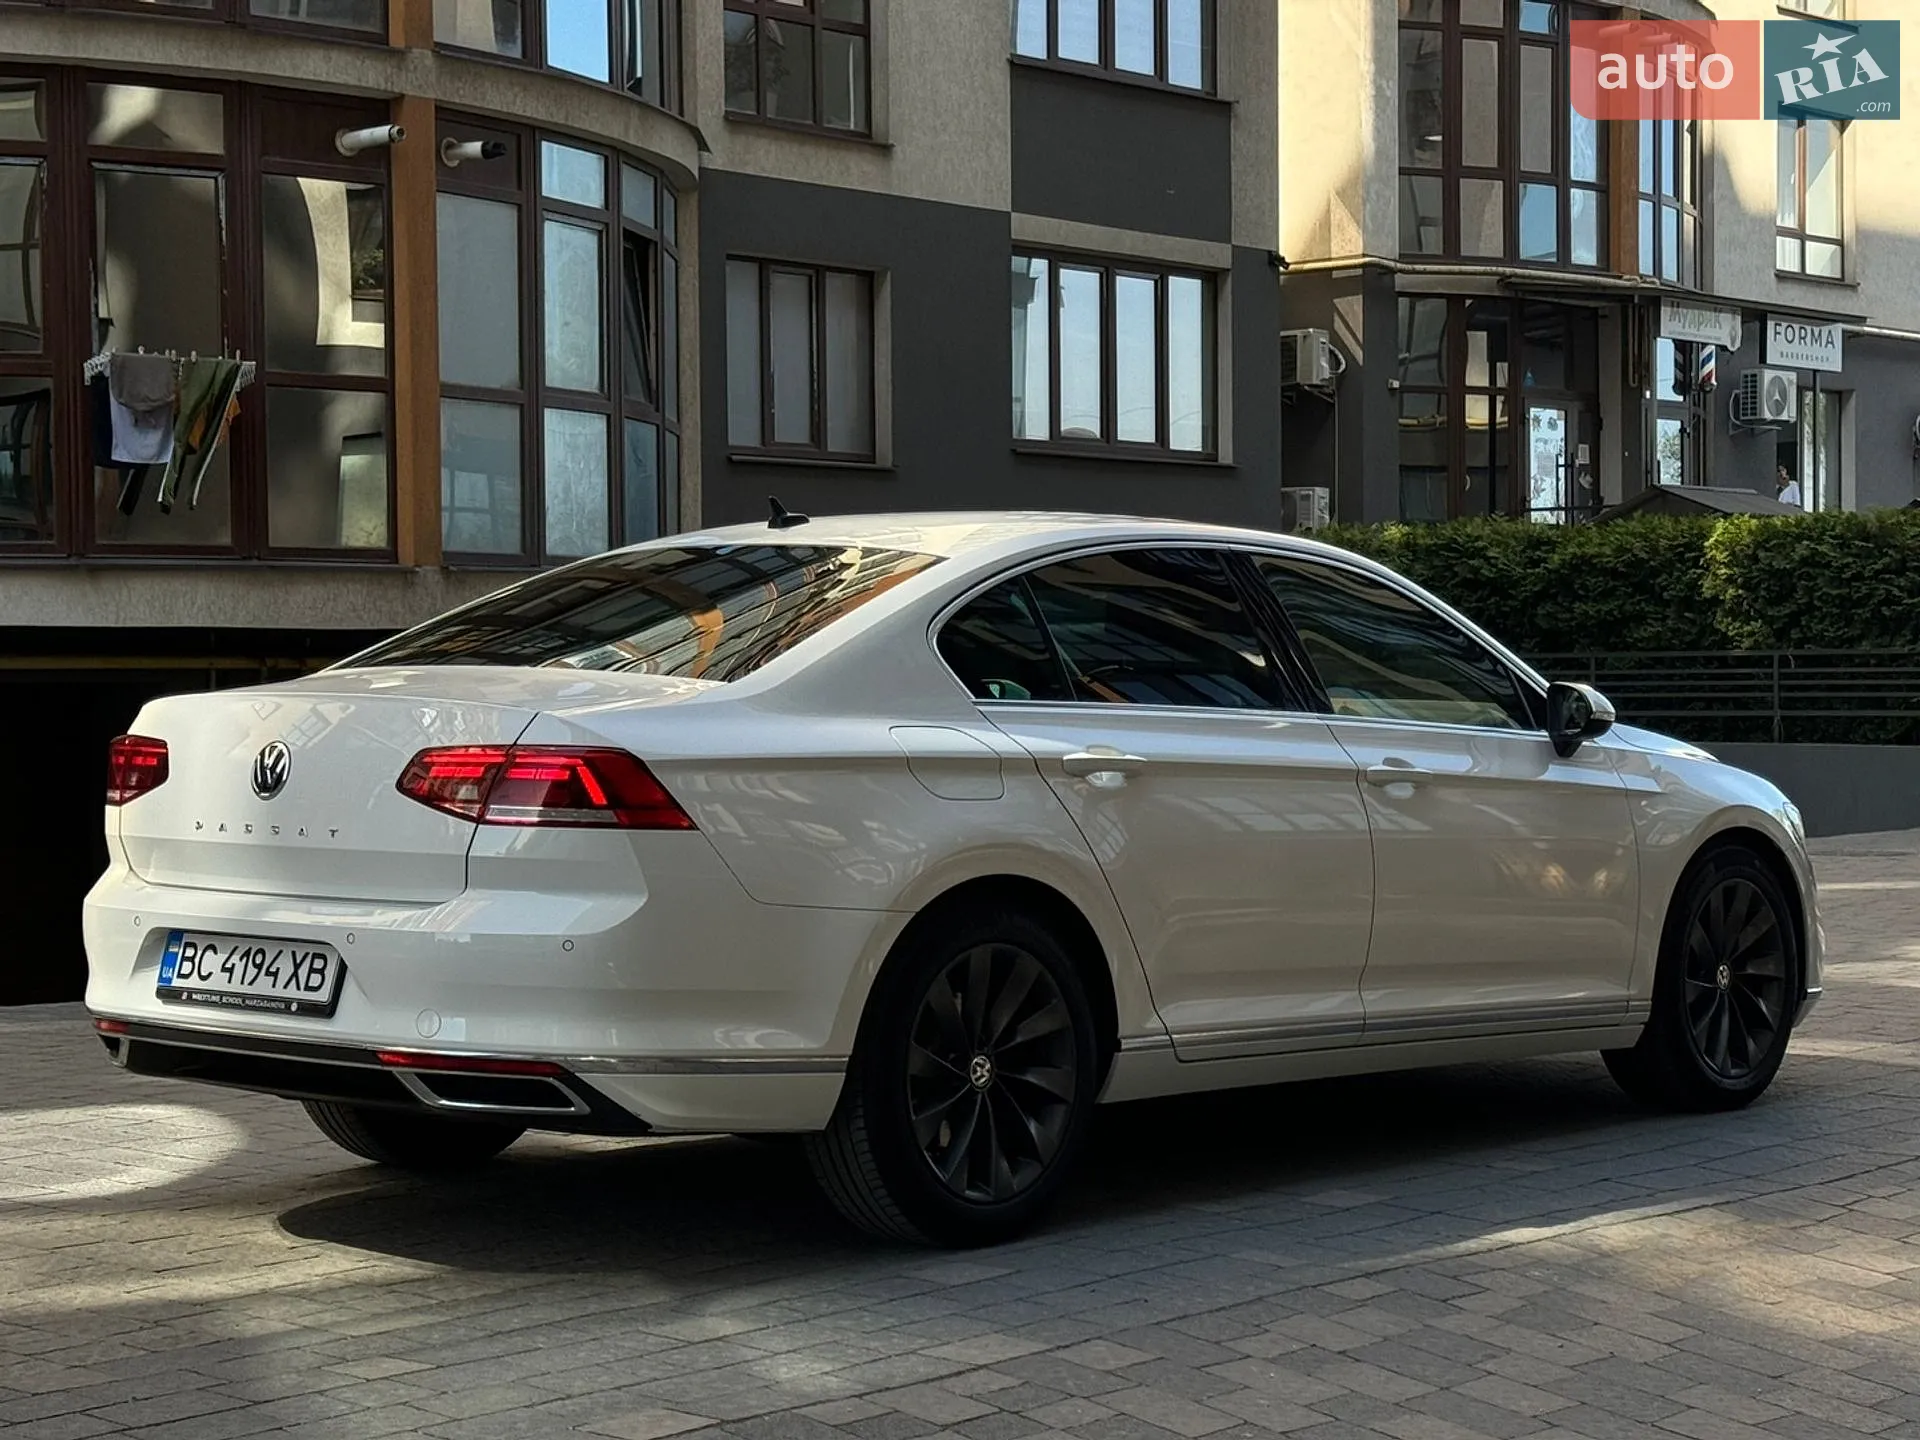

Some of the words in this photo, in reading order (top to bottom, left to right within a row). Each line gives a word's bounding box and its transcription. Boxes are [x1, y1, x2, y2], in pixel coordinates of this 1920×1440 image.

[1774, 322, 1836, 349] FORMA
[176, 941, 218, 982] BC
[220, 944, 284, 989] 4194
[282, 950, 329, 992] XB
